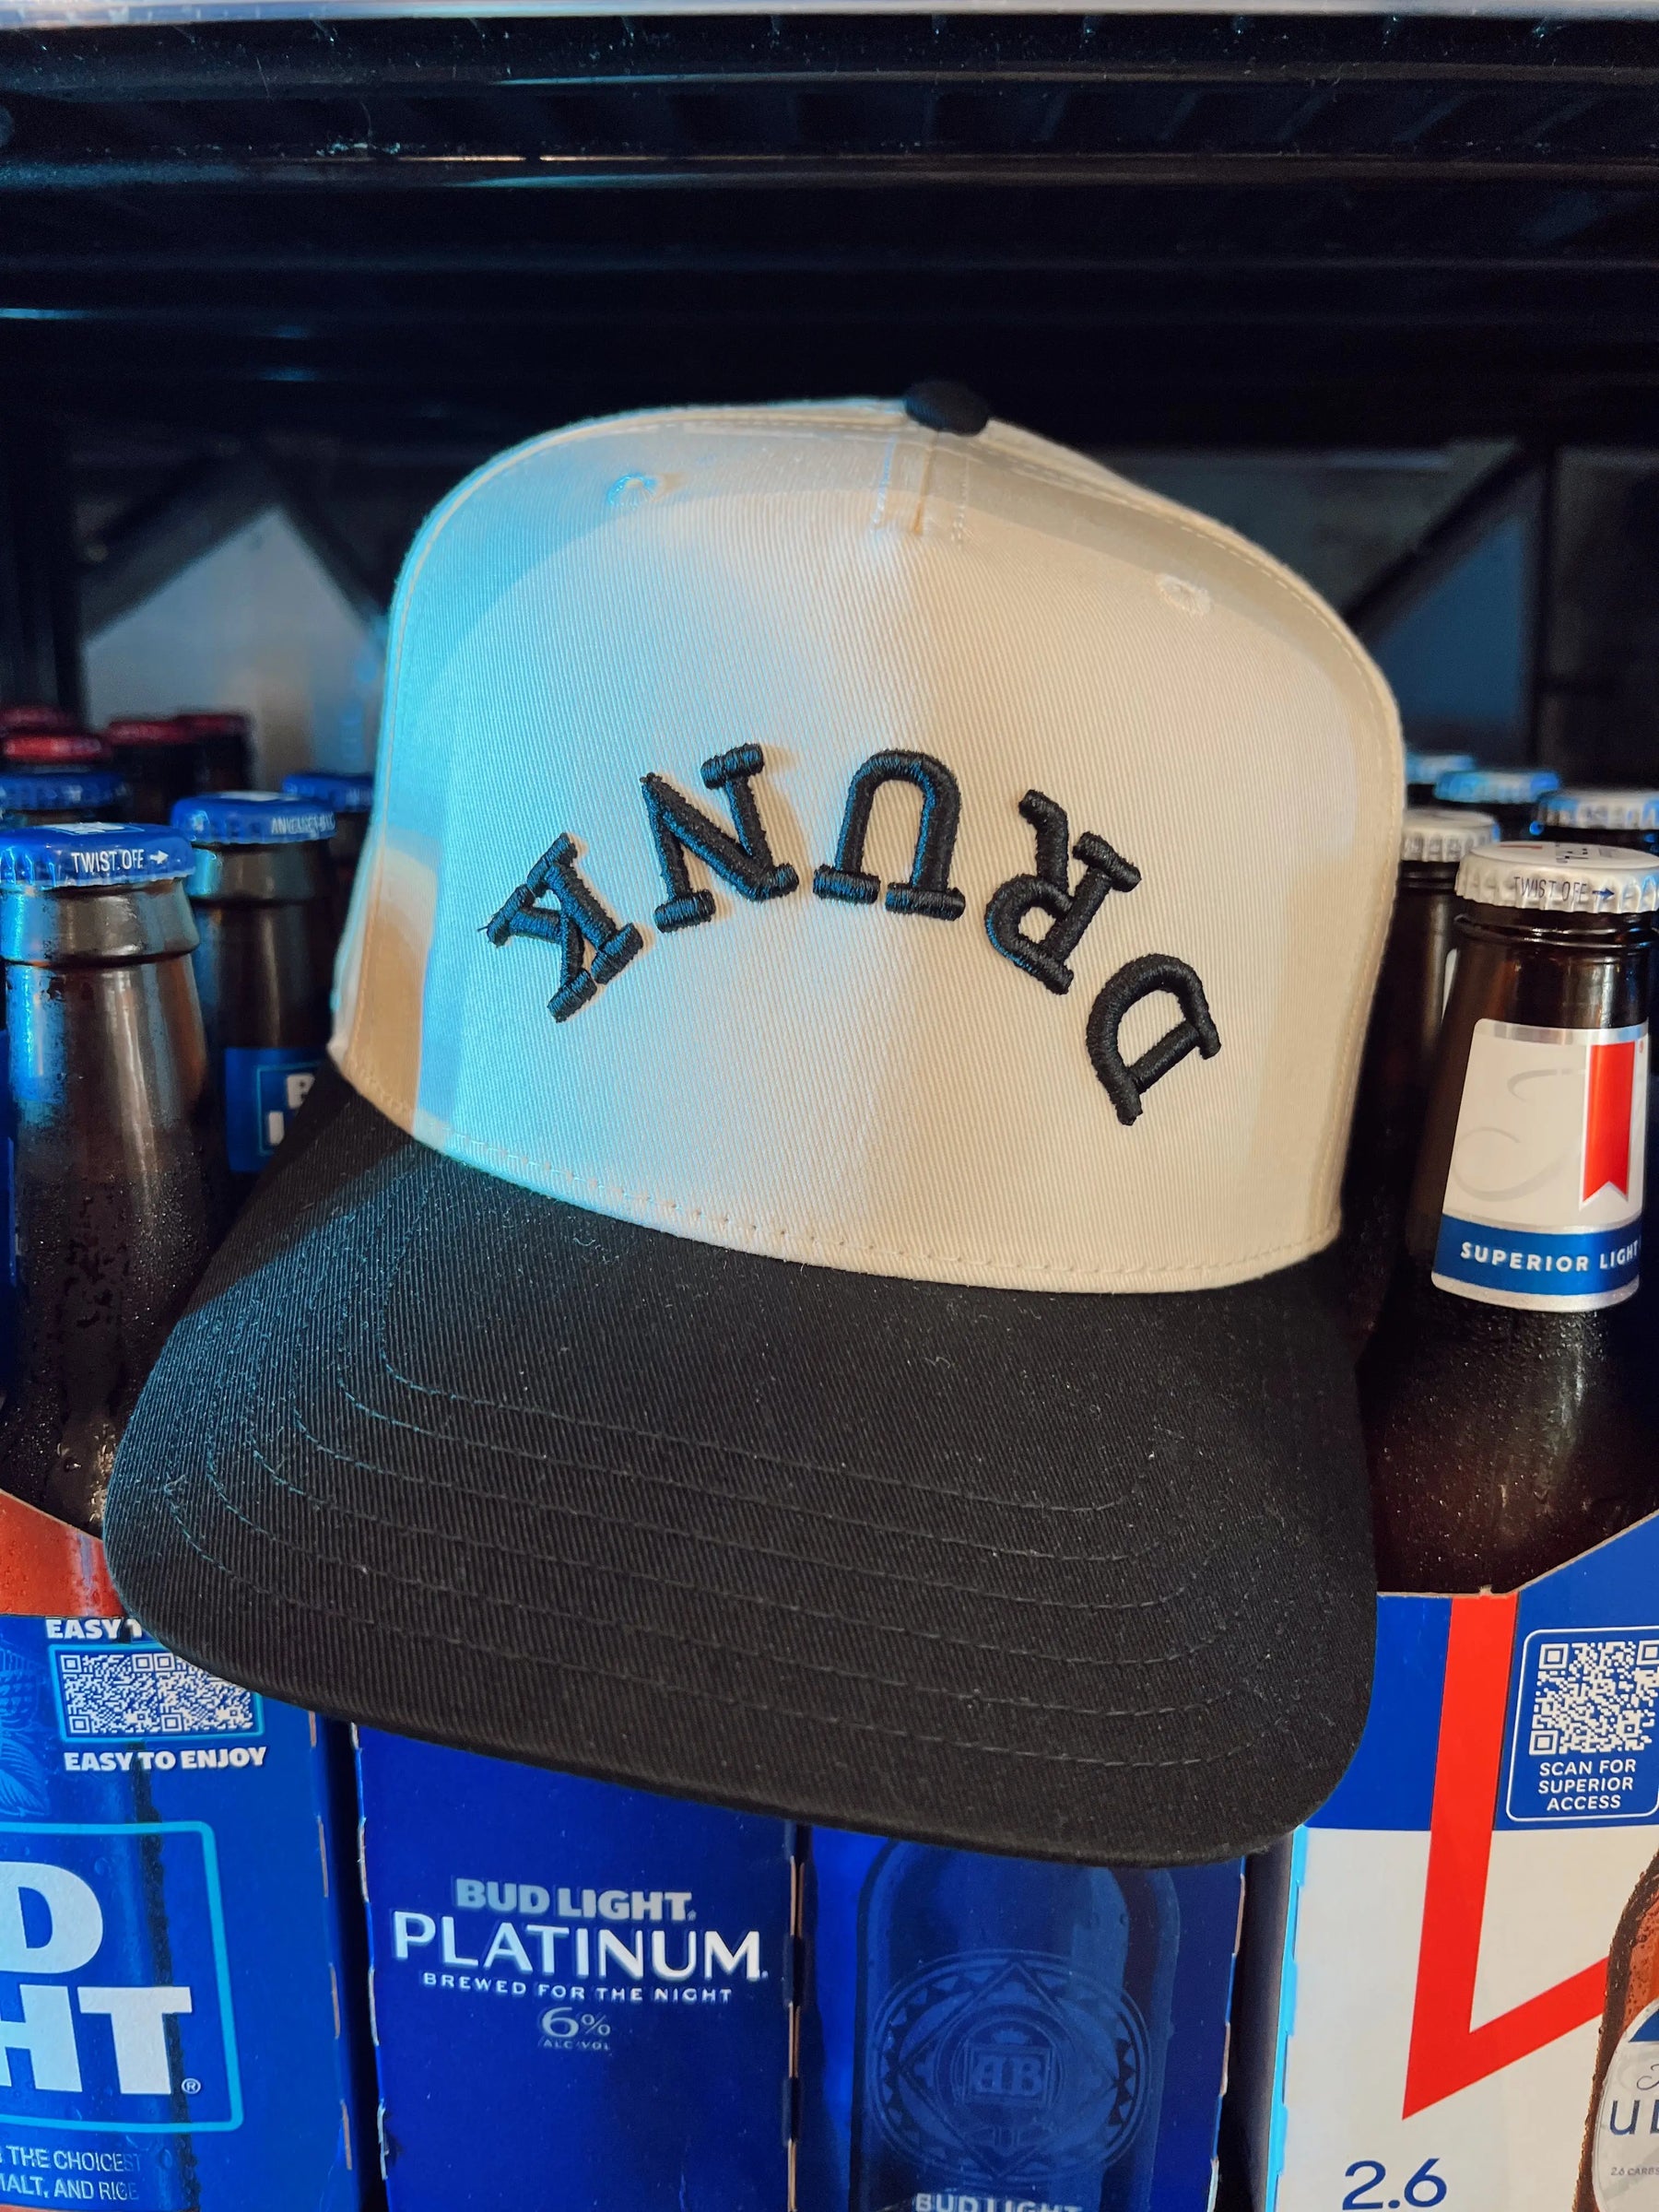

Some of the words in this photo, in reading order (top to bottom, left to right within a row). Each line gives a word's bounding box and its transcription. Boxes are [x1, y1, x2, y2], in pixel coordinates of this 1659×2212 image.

[71, 850, 119, 873] TWIST
[122, 849, 144, 870] OFF
[1513, 877, 1557, 899] TWIST
[1561, 880, 1587, 902] OFF
[486, 742, 1220, 1127] DRUNK
[1460, 1241, 1589, 1272] SUPERIOR
[1599, 1240, 1639, 1270] LIGHT
[46, 1618, 121, 1640] EASY
[64, 1752, 134, 1771] EASY
[139, 1751, 175, 1771] TO
[181, 1747, 267, 1768] ENJOY
[1539, 1760, 1593, 1776] SCAN
[1599, 1759, 1637, 1773] FOR
[1538, 1777, 1634, 1794] SUPERIOR
[1547, 1794, 1621, 1811] ACCESS
[455, 1877, 550, 1915] BUD
[0, 1860, 103, 1974] D
[423, 1972, 527, 1995] BREWED
[537, 1983, 585, 2001] FOR
[596, 1987, 643, 2003] THE
[653, 1988, 733, 2004] NIGHT
[542, 2006, 610, 2038] 6%
[6, 2145, 51, 2169] THE
[53, 2149, 141, 2172] CHOICEST
[53, 2179, 94, 2200] AND
[99, 2181, 138, 2201] RICE
[1342, 2158, 1448, 2211] 2.6
[915, 2193, 979, 2212] BUD
